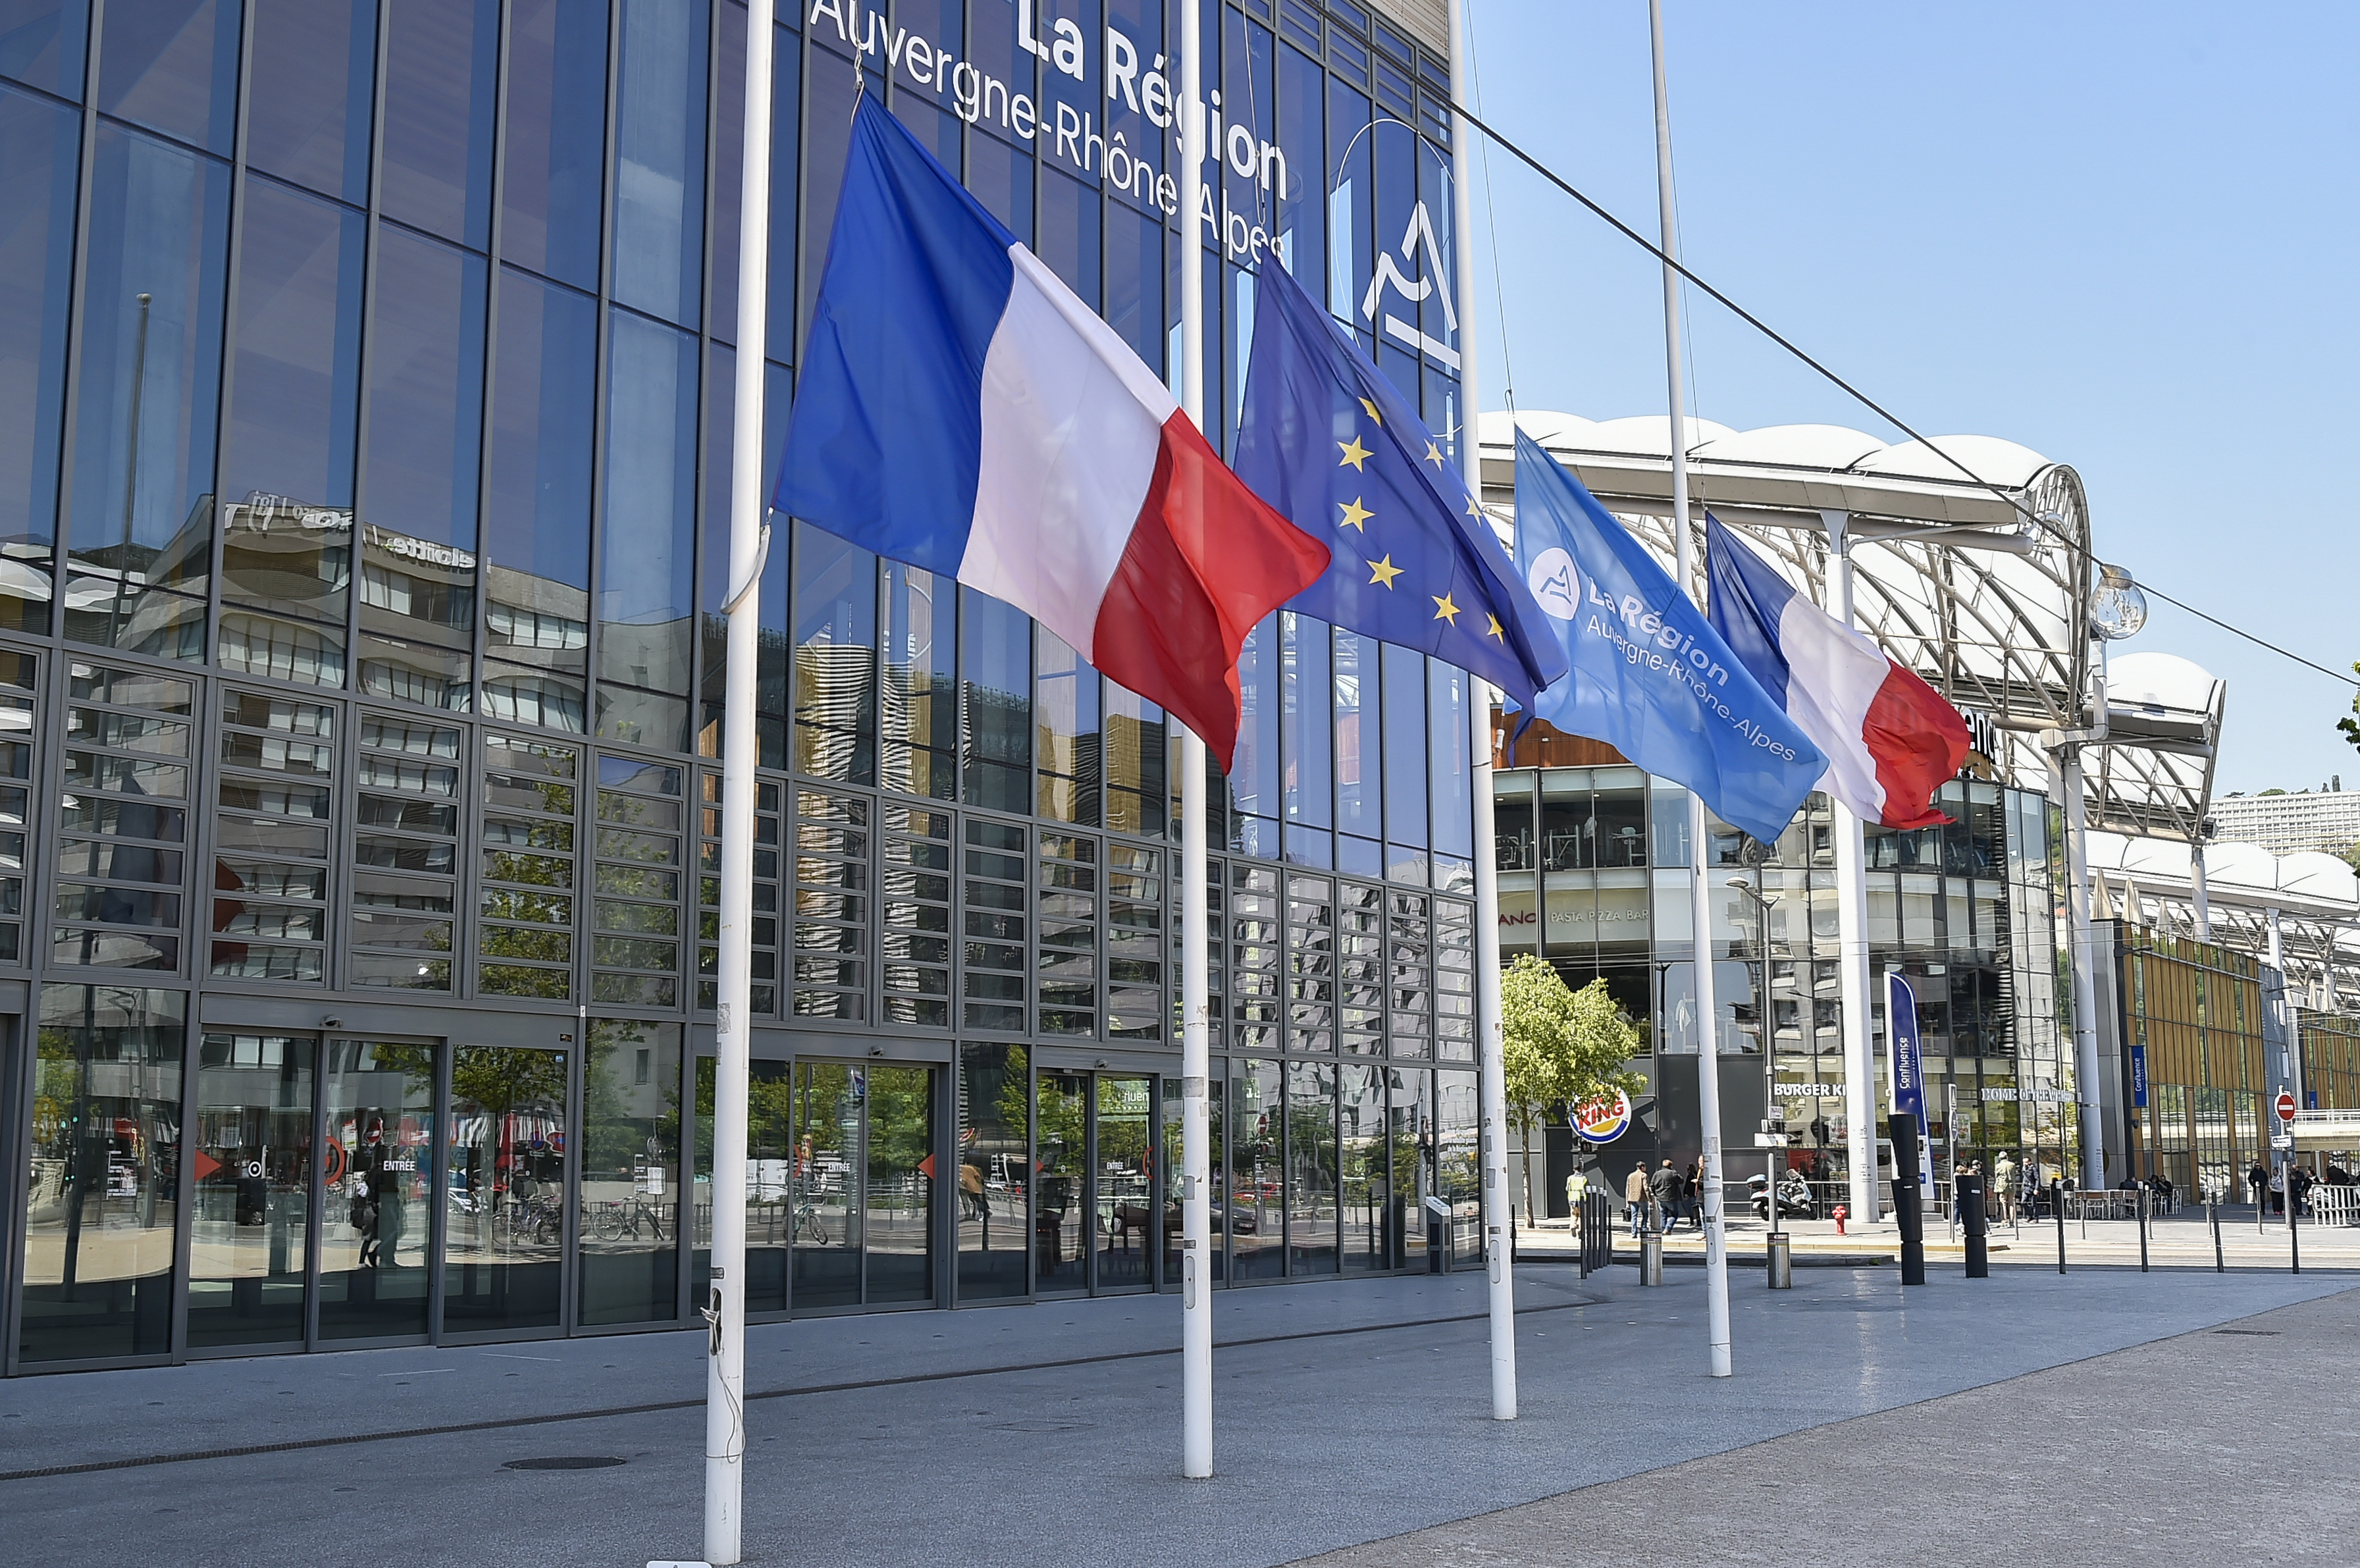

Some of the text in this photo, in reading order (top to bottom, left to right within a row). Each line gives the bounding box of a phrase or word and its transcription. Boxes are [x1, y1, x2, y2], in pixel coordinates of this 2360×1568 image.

[1018, 0, 1084, 82] La
[1589, 576, 1729, 687] La Région
[1587, 614, 1796, 761] Auvergne-Rhône-Alpes
[1551, 912, 1583, 922] PASTA
[1588, 910, 1621, 922] PZZA
[1899, 1037, 1911, 1089] Confluence
[1774, 1083, 1846, 1096] BURGER KI
[1981, 1088, 2017, 1101] HOME
[1579, 1101, 1624, 1130] KING
[384, 1159, 415, 1170] ENTRÉE
[828, 1161, 851, 1172] ENTRÉE
[1107, 1161, 1124, 1170] ENTRÉE
